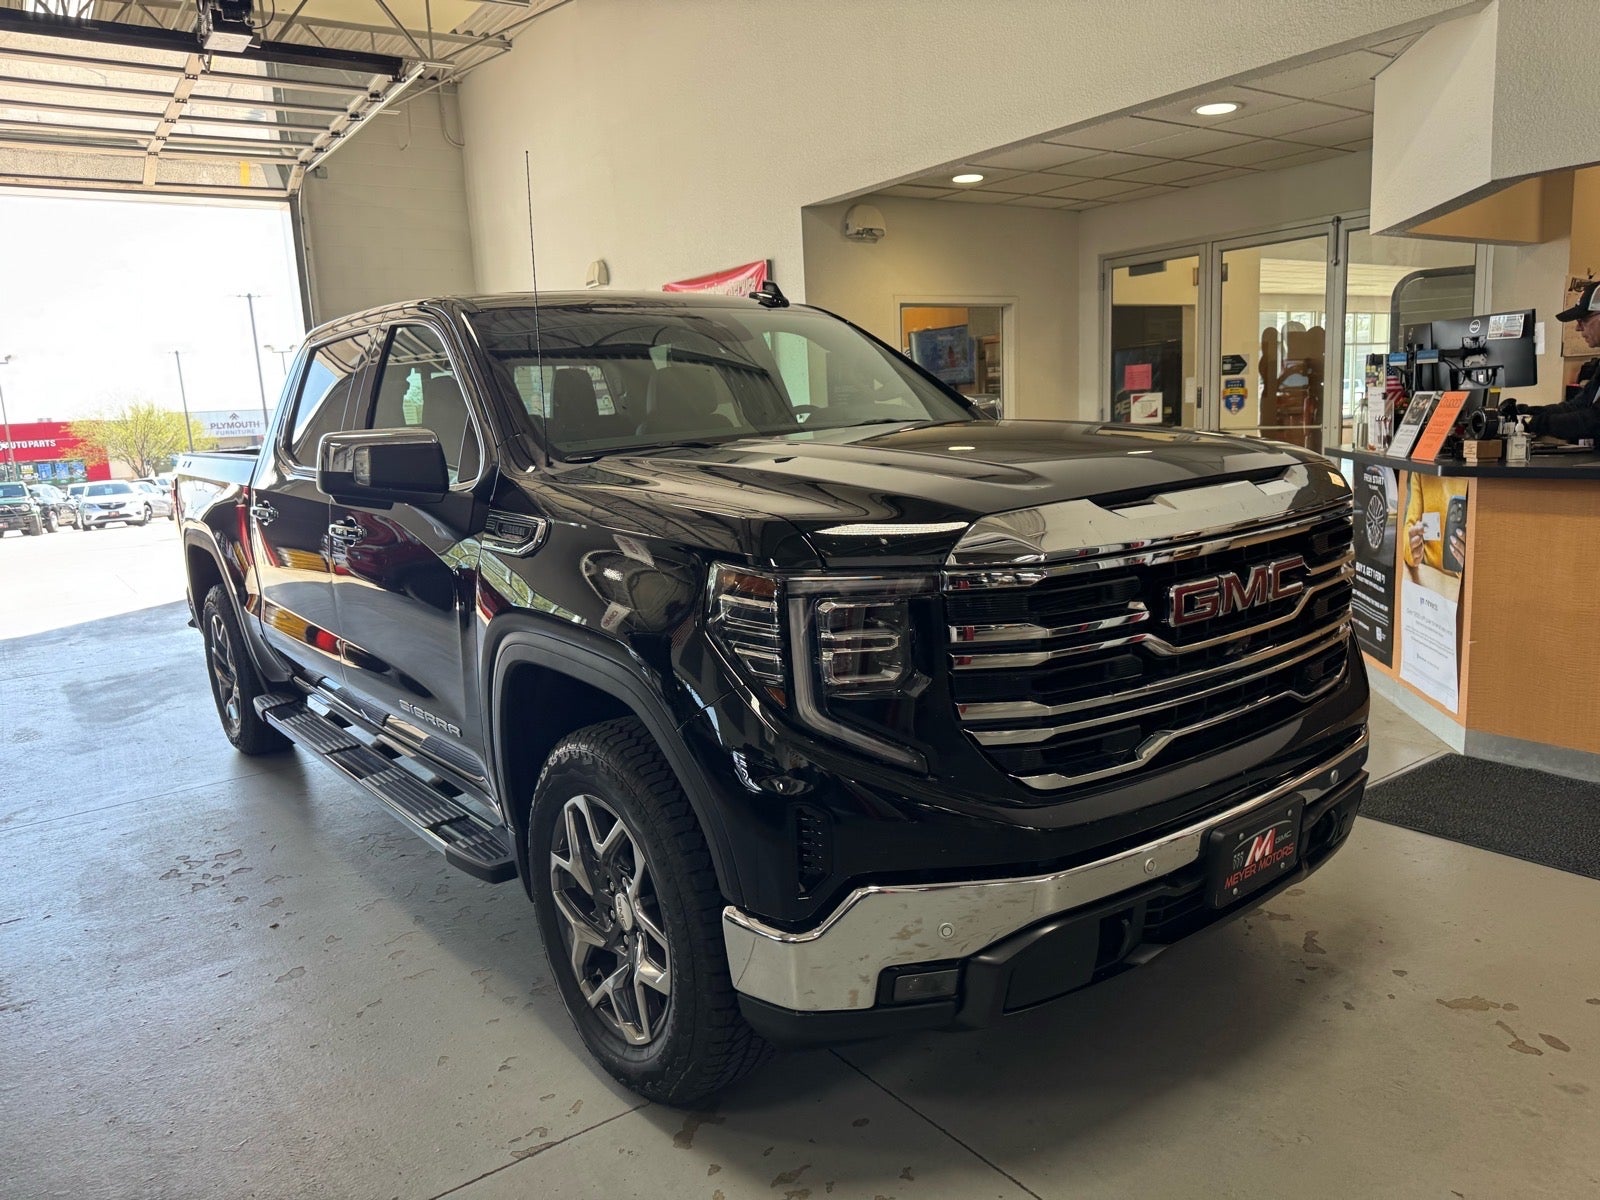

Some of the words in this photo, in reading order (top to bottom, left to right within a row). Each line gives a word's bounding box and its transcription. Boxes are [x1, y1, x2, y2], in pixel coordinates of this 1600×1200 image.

[28, 439, 56, 448] PARTS
[210, 421, 260, 429] PLYMOUTH
[1169, 555, 1303, 627] GMC
[399, 699, 462, 738] SIERRA
[1224, 863, 1257, 890] MEYER
[1258, 842, 1295, 872] MOTORS
